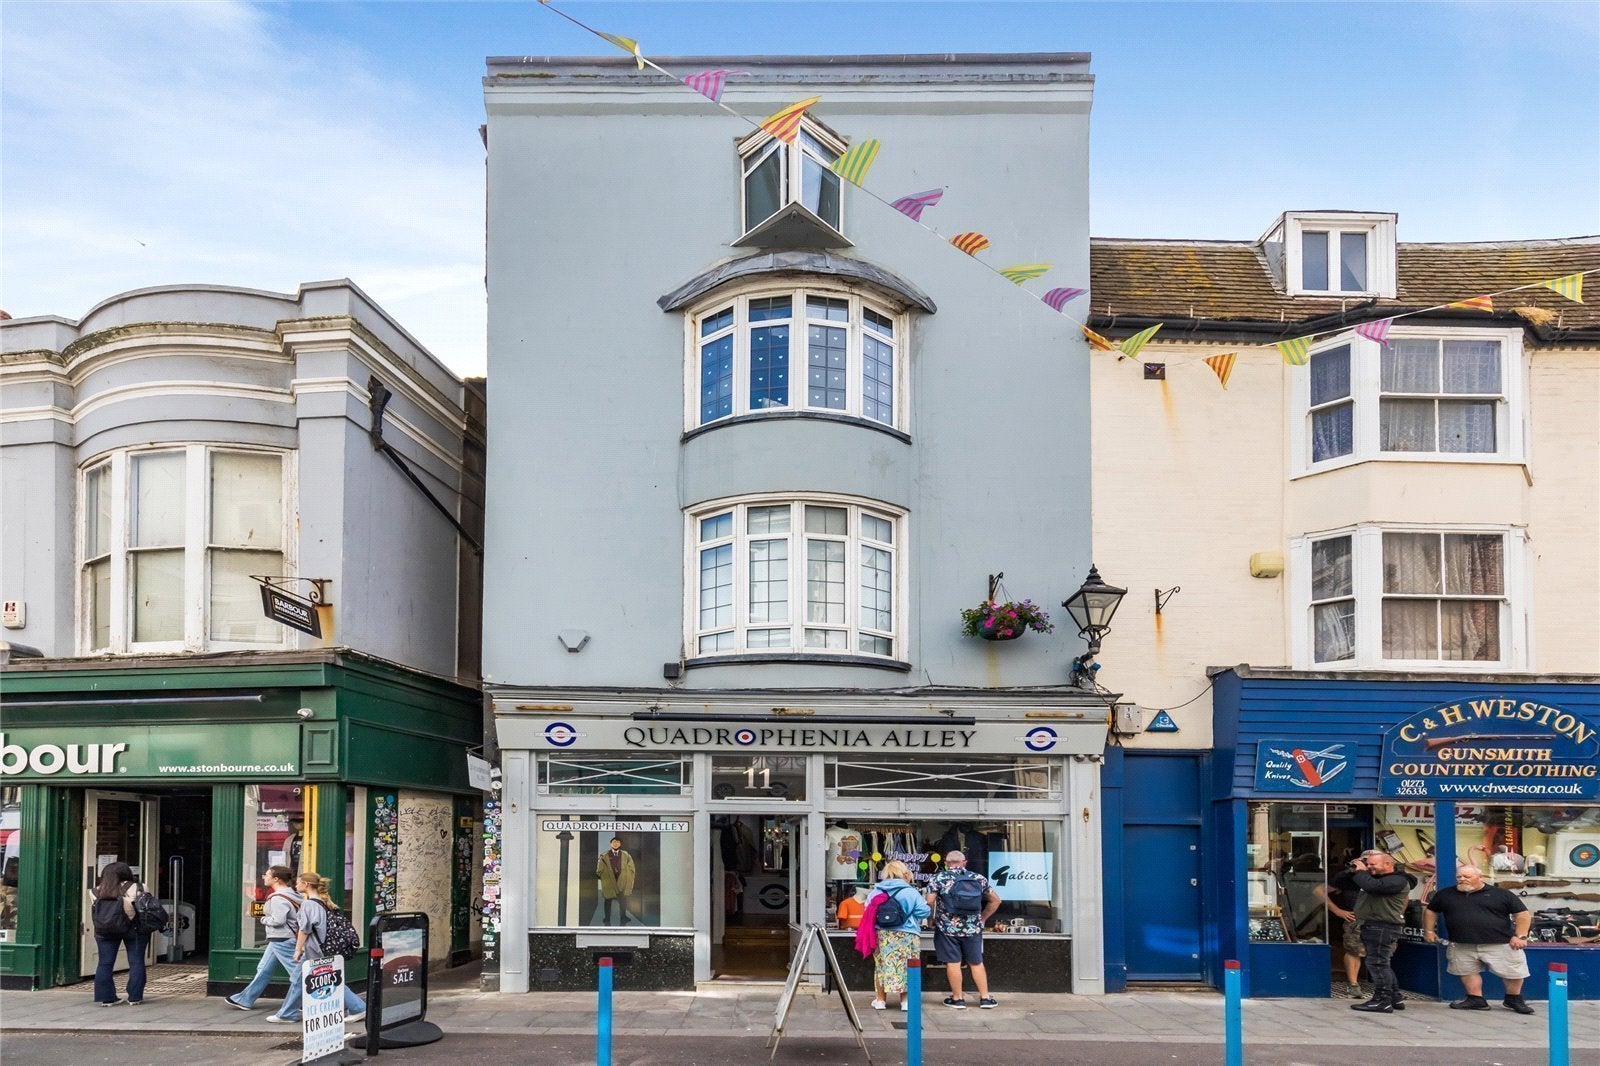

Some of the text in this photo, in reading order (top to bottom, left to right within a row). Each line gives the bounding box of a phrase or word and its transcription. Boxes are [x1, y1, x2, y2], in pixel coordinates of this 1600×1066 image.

[274, 598, 308, 618] BARBOUR
[1423, 718, 1438, 730] &
[624, 727, 977, 747] QUADROPHENIA ALLEY
[1437, 747, 1553, 761] GUNSMITH
[159, 763, 295, 773] www.astonbourne.co.uk
[1265, 760, 1292, 771] Quality
[1389, 763, 1597, 777] COUNTRY CLOTHING
[742, 768, 773, 789] 11
[1265, 770, 1291, 780] Knives
[1401, 779, 1425, 788] 01273
[1439, 782, 1582, 795] www.chweston.co.uk
[1395, 787, 1427, 796] 326338
[546, 822, 686, 831] QUADROPHENIA ALLEY
[887, 850, 929, 862] Happy
[990, 865, 1049, 887] Gabicci
[393, 971, 414, 985] SALE
[305, 1010, 344, 1034] FOR DOGS
